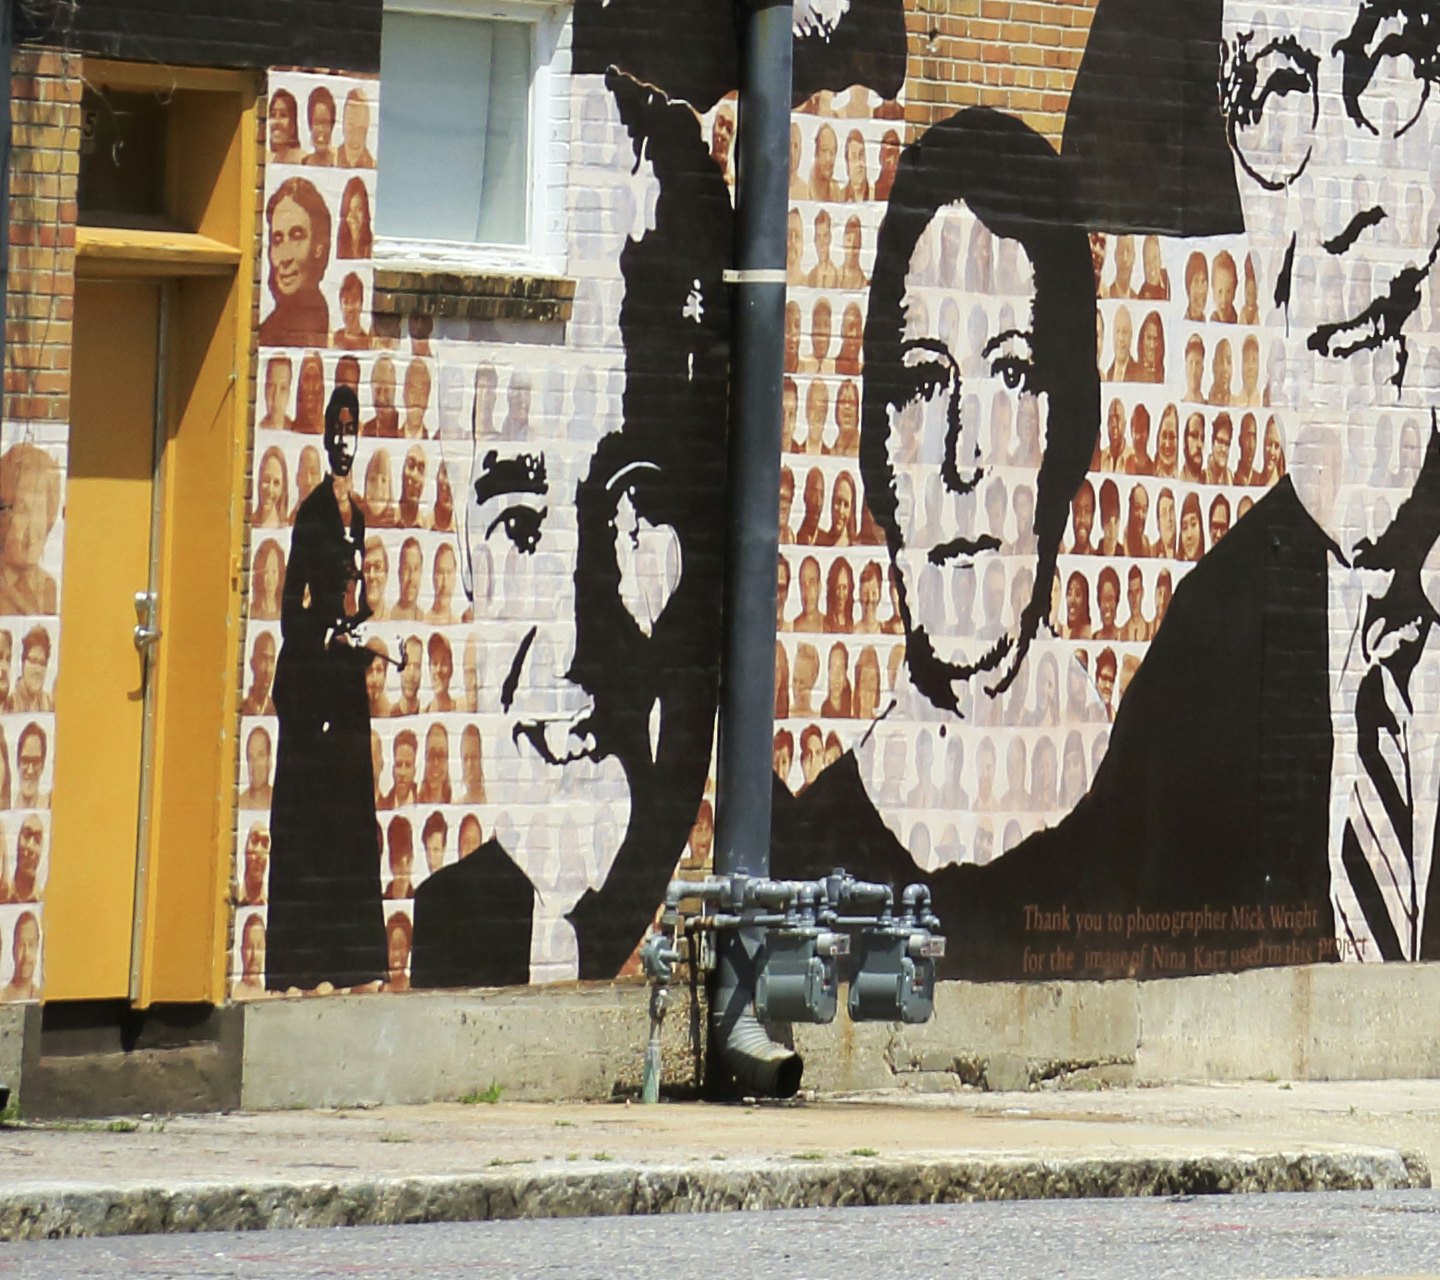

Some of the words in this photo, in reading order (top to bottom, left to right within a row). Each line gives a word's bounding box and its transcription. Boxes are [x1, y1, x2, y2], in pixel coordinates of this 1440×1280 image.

[1023, 903, 1071, 931] Thank
[1076, 912, 1102, 938] you
[1108, 911, 1123, 931] to
[1126, 905, 1228, 939] photographer
[1230, 904, 1265, 930] Mick
[1270, 903, 1319, 935] Wright
[1023, 945, 1045, 973] for
[1050, 945, 1075, 970] the
[1129, 943, 1148, 970] of
[1152, 943, 1187, 970] Nina
[1230, 940, 1264, 965] used
[1265, 940, 1281, 962] in
[1285, 939, 1313, 963] this
[1318, 937, 1369, 962] project
